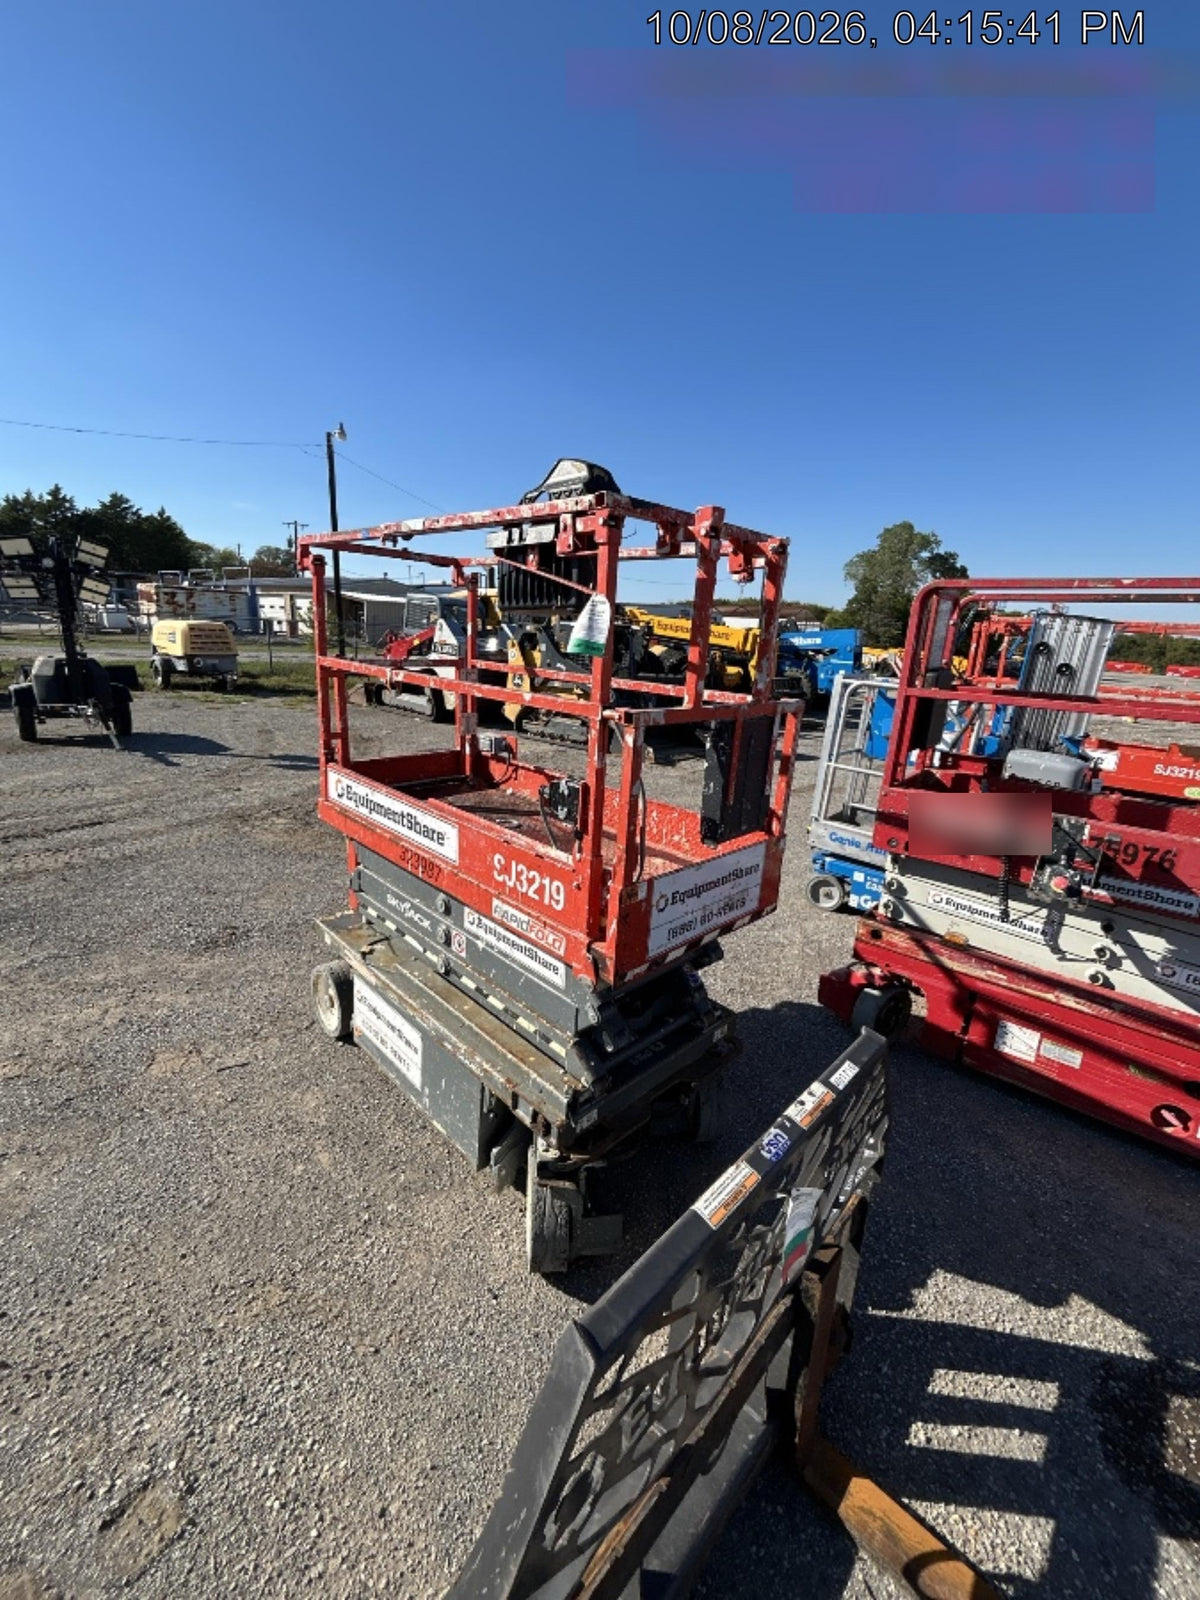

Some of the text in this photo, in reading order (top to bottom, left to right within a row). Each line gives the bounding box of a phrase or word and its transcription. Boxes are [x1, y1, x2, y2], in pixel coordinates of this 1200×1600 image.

[345, 783, 446, 846] EquipmentShare
[493, 853, 565, 911] SJ3219
[671, 863, 760, 906] EquipmentShare
[476, 913, 560, 976] EquipmentShare
